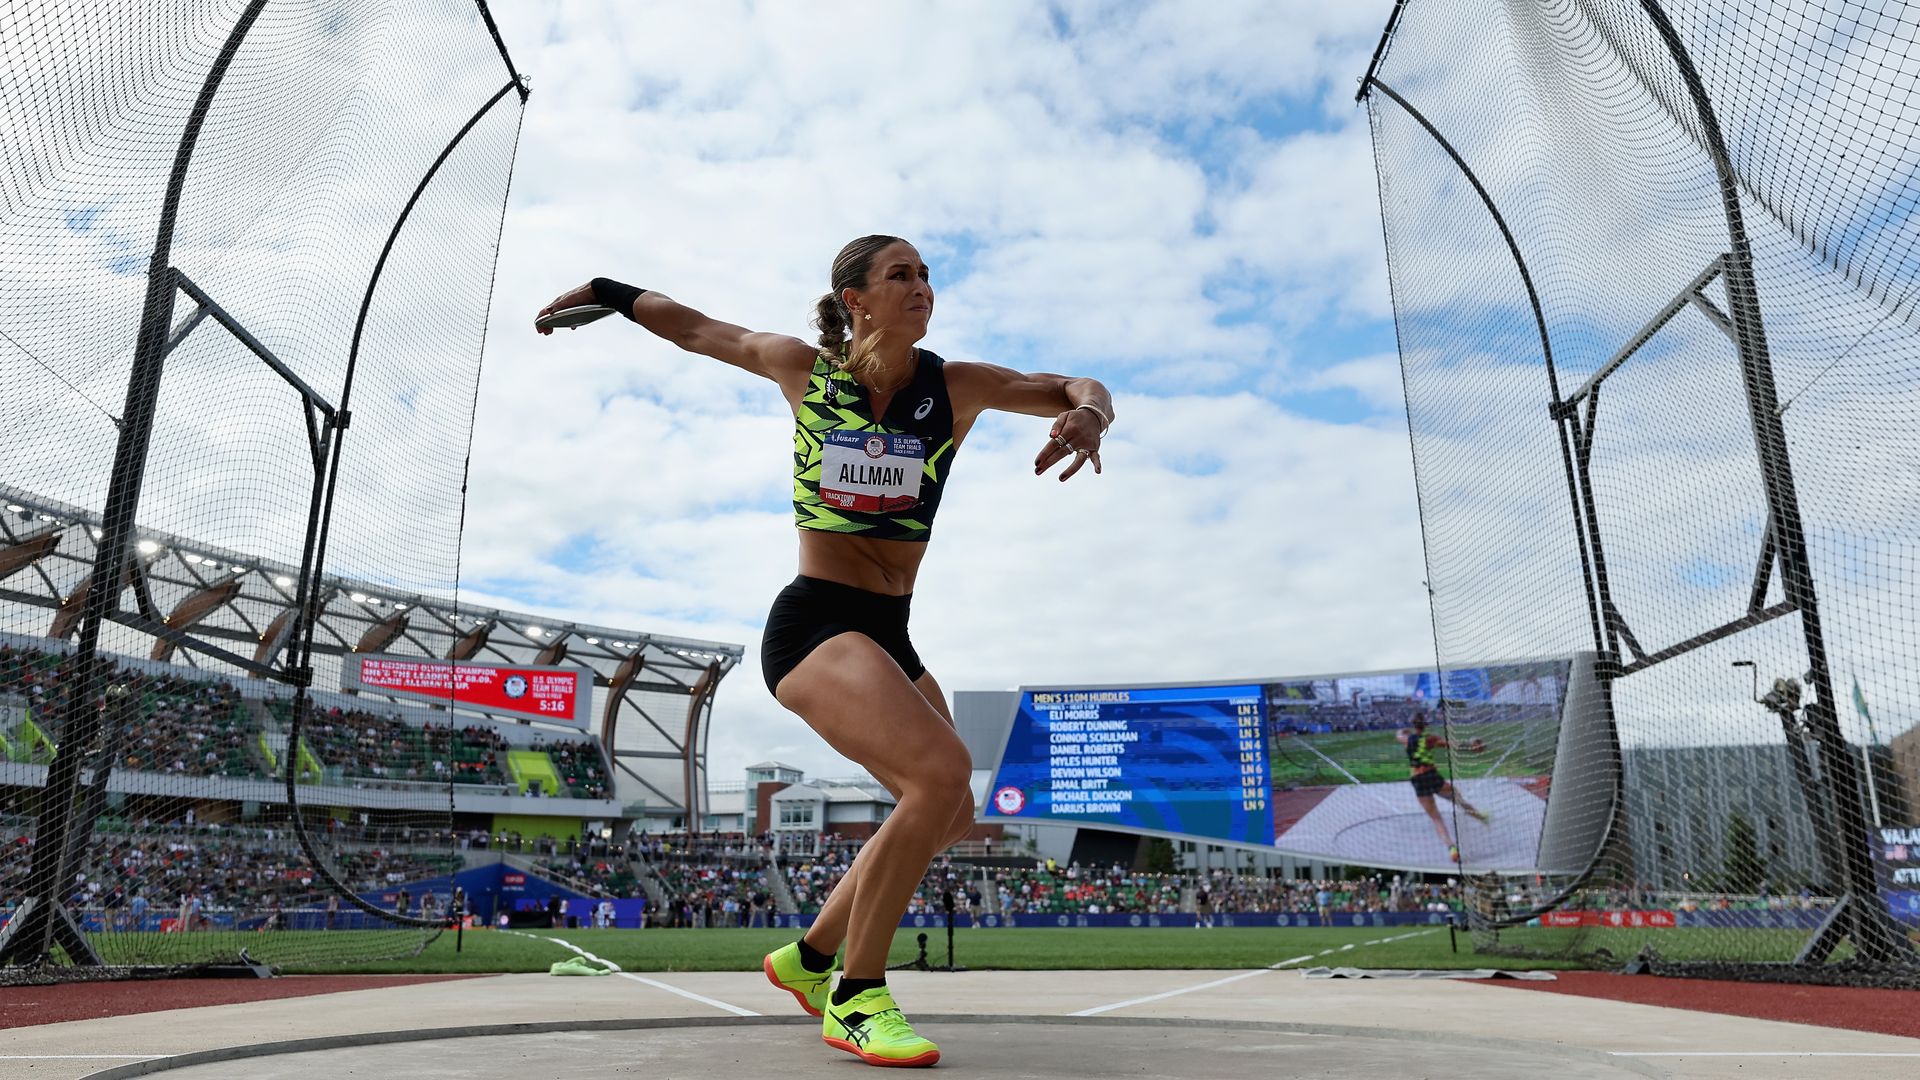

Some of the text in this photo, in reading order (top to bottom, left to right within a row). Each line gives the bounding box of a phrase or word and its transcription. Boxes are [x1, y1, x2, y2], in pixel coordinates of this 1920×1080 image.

[839, 463, 904, 486] ALLMAN
[825, 492, 855, 502] TRACKTOWN
[413, 672, 448, 681] LEADER
[456, 667, 497, 677] CHAMPION,
[405, 678, 440, 688] ALLMAN
[546, 676, 574, 685] OLYMPIC
[552, 684, 573, 693] TRIALS
[1034, 692, 1130, 703] MEN'S 110M HURDLES
[540, 700, 565, 711] 5:16
[1238, 705, 1258, 715] LN 1
[1050, 710, 1099, 720] ELI MORRIS
[1050, 720, 1128, 731] ROBERT DUNNING
[1239, 717, 1259, 727] LN 2
[1050, 732, 1138, 743] CONNOR SCHULMAN
[1239, 729, 1260, 738] LN 3
[1050, 744, 1125, 755] DANIEL ROBERTS
[1240, 741, 1261, 750] LN 4
[1051, 756, 1118, 766] MYLES HUNTER
[1241, 752, 1261, 762] LN 5
[1051, 767, 1121, 778] DEVION WILSON
[1241, 764, 1262, 774] LN 6
[1051, 779, 1108, 789] JAMAL BRITT
[1242, 776, 1263, 786] LN 7
[1052, 791, 1132, 801] MICHAEL DICKSON
[1243, 788, 1264, 798] LN 8
[1052, 803, 1121, 813] DARIUS BROWN
[1244, 800, 1264, 811] LN 9
